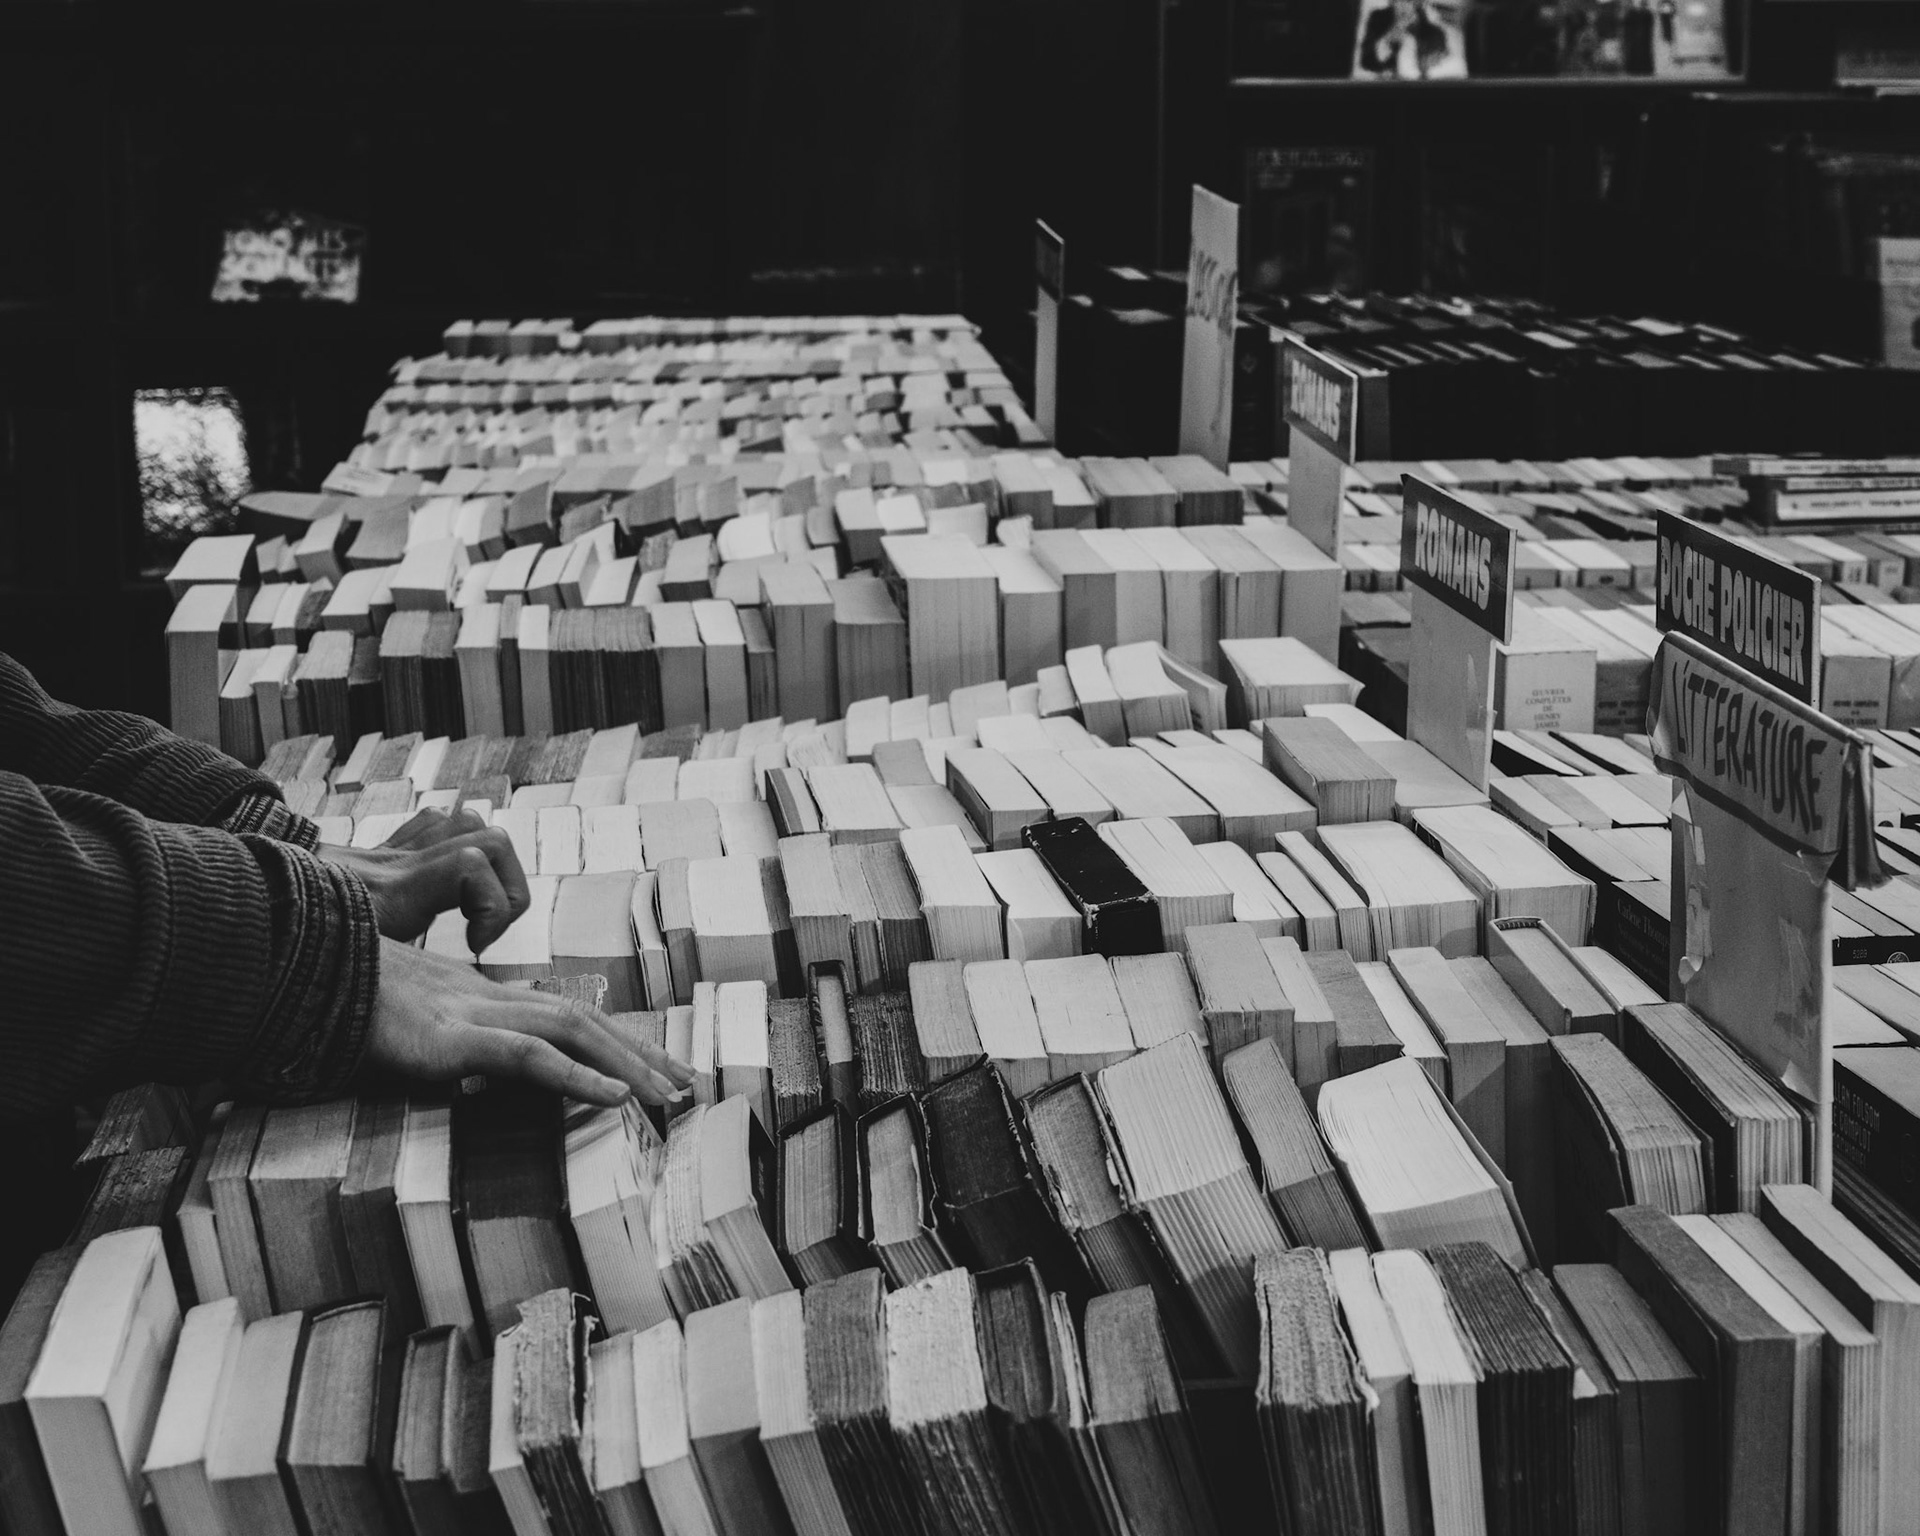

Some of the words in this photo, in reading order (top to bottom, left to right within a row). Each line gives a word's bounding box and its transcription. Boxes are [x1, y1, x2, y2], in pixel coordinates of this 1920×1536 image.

[1415, 501, 1492, 610] ROMANS
[1660, 535, 1715, 638] POCHE
[1720, 564, 1805, 686] POLICIER
[1833, 1080, 1851, 1111] LLAN
[1853, 1092, 1880, 1134] FOLSOM
[1839, 1110, 1871, 1153] COMPLOT
